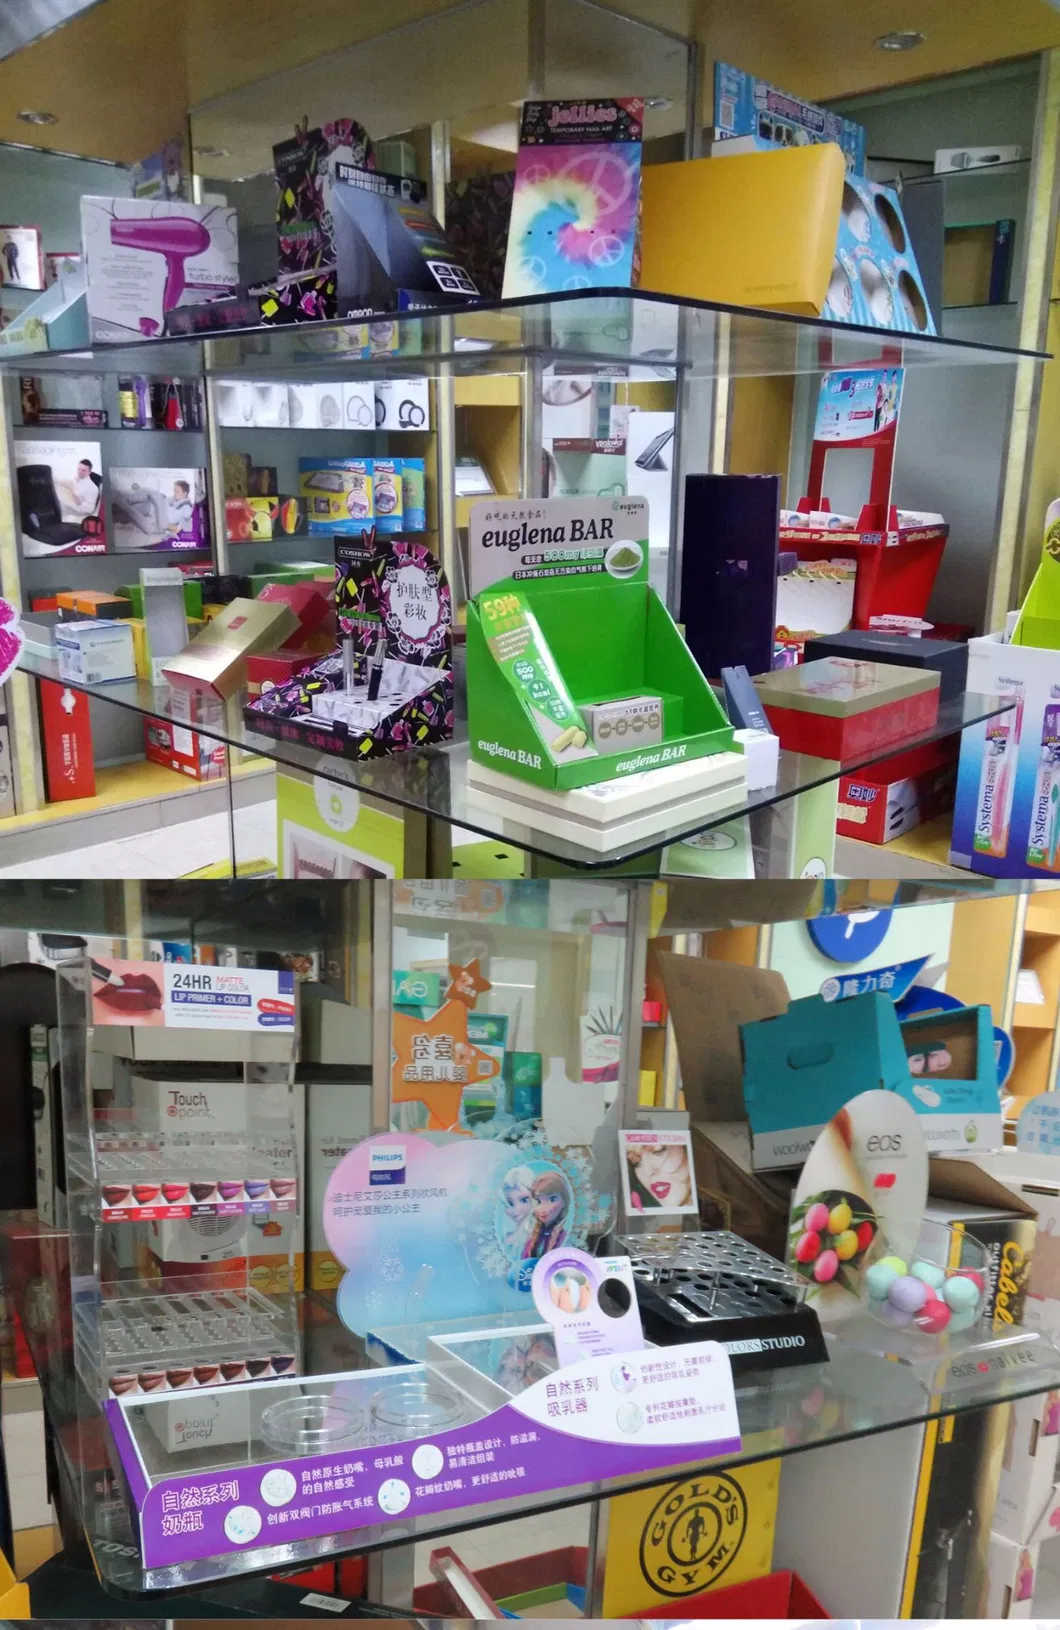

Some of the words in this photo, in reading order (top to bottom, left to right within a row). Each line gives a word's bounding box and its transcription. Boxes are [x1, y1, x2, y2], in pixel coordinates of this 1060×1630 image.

[548, 105, 617, 127] jellies
[620, 502, 645, 511] euglena
[171, 541, 197, 549] CONAIR
[481, 522, 566, 552] euglena
[570, 518, 614, 542] BAR
[75, 544, 106, 552] CONAIR
[396, 582, 432, 602] 护肤型
[404, 602, 427, 621] 彩妆
[516, 665, 534, 675] 500
[532, 682, 544, 691] 91
[998, 676, 1024, 687] Systema
[532, 690, 551, 699] kcal
[478, 739, 517, 763] euglena
[517, 751, 542, 770] BAR
[615, 754, 660, 772] euglena
[661, 744, 688, 761] BAR
[978, 784, 995, 833] Systema
[1031, 796, 1050, 846] Systema
[172, 973, 212, 990] 24HR
[216, 975, 244, 985] MATTE
[843, 971, 897, 998] 隆力奇
[173, 993, 187, 1002] LIP
[188, 994, 216, 1004] PRIMER
[224, 995, 249, 1005] COLOR
[168, 1091, 208, 1106] Touch
[867, 1133, 903, 1153] eos
[761, 1335, 806, 1351] STUDIO
[546, 1376, 599, 1399] 自然系列
[547, 1397, 589, 1418] 吸乳器
[448, 1452, 495, 1469] 易清洁组装
[302, 1476, 356, 1495] 的自然感受
[160, 1480, 240, 1512] 自然系列
[266, 1494, 375, 1525] 创新双阀门防胀气系统
[651, 1483, 742, 1549] GOLD'S
[161, 1510, 204, 1536] 奶瓶
[656, 1545, 731, 1586] GYM
